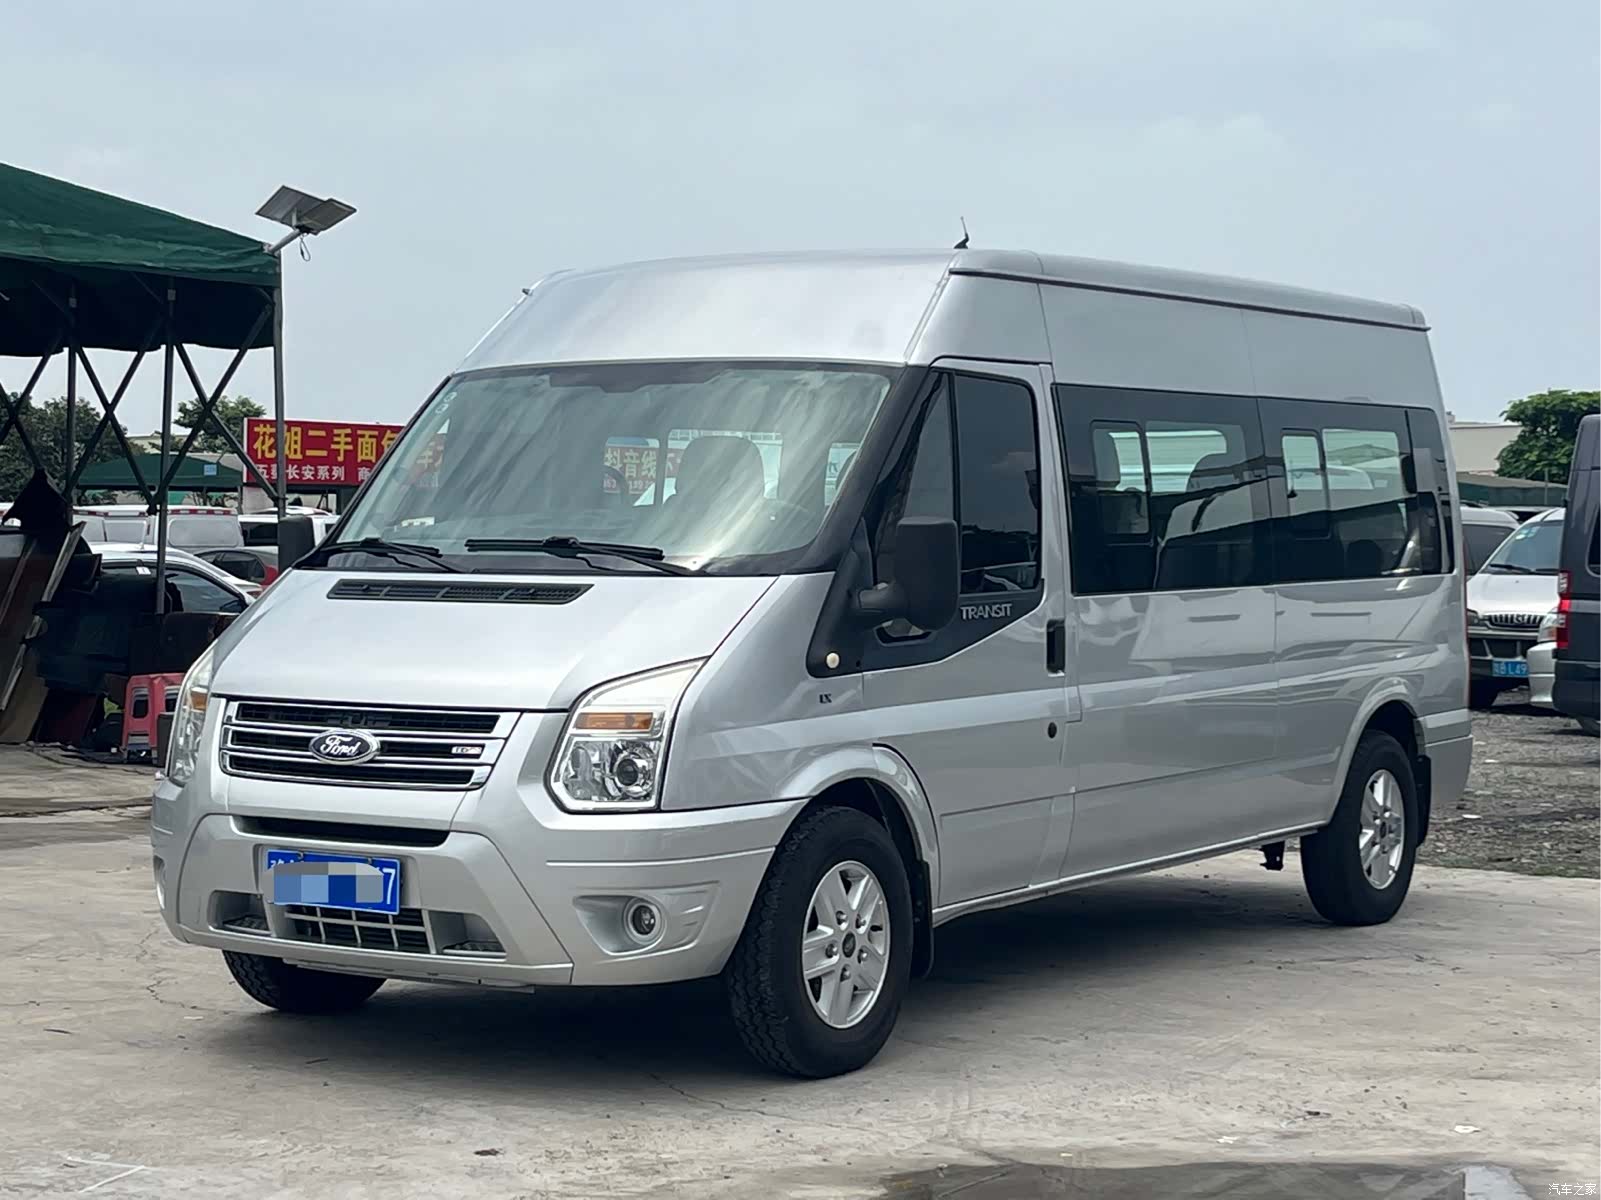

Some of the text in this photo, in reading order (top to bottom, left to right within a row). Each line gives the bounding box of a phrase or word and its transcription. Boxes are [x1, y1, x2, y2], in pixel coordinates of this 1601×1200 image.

[960, 603, 1013, 620] TRANSIT
[819, 693, 832, 704] LX
[320, 734, 362, 757] Ford
